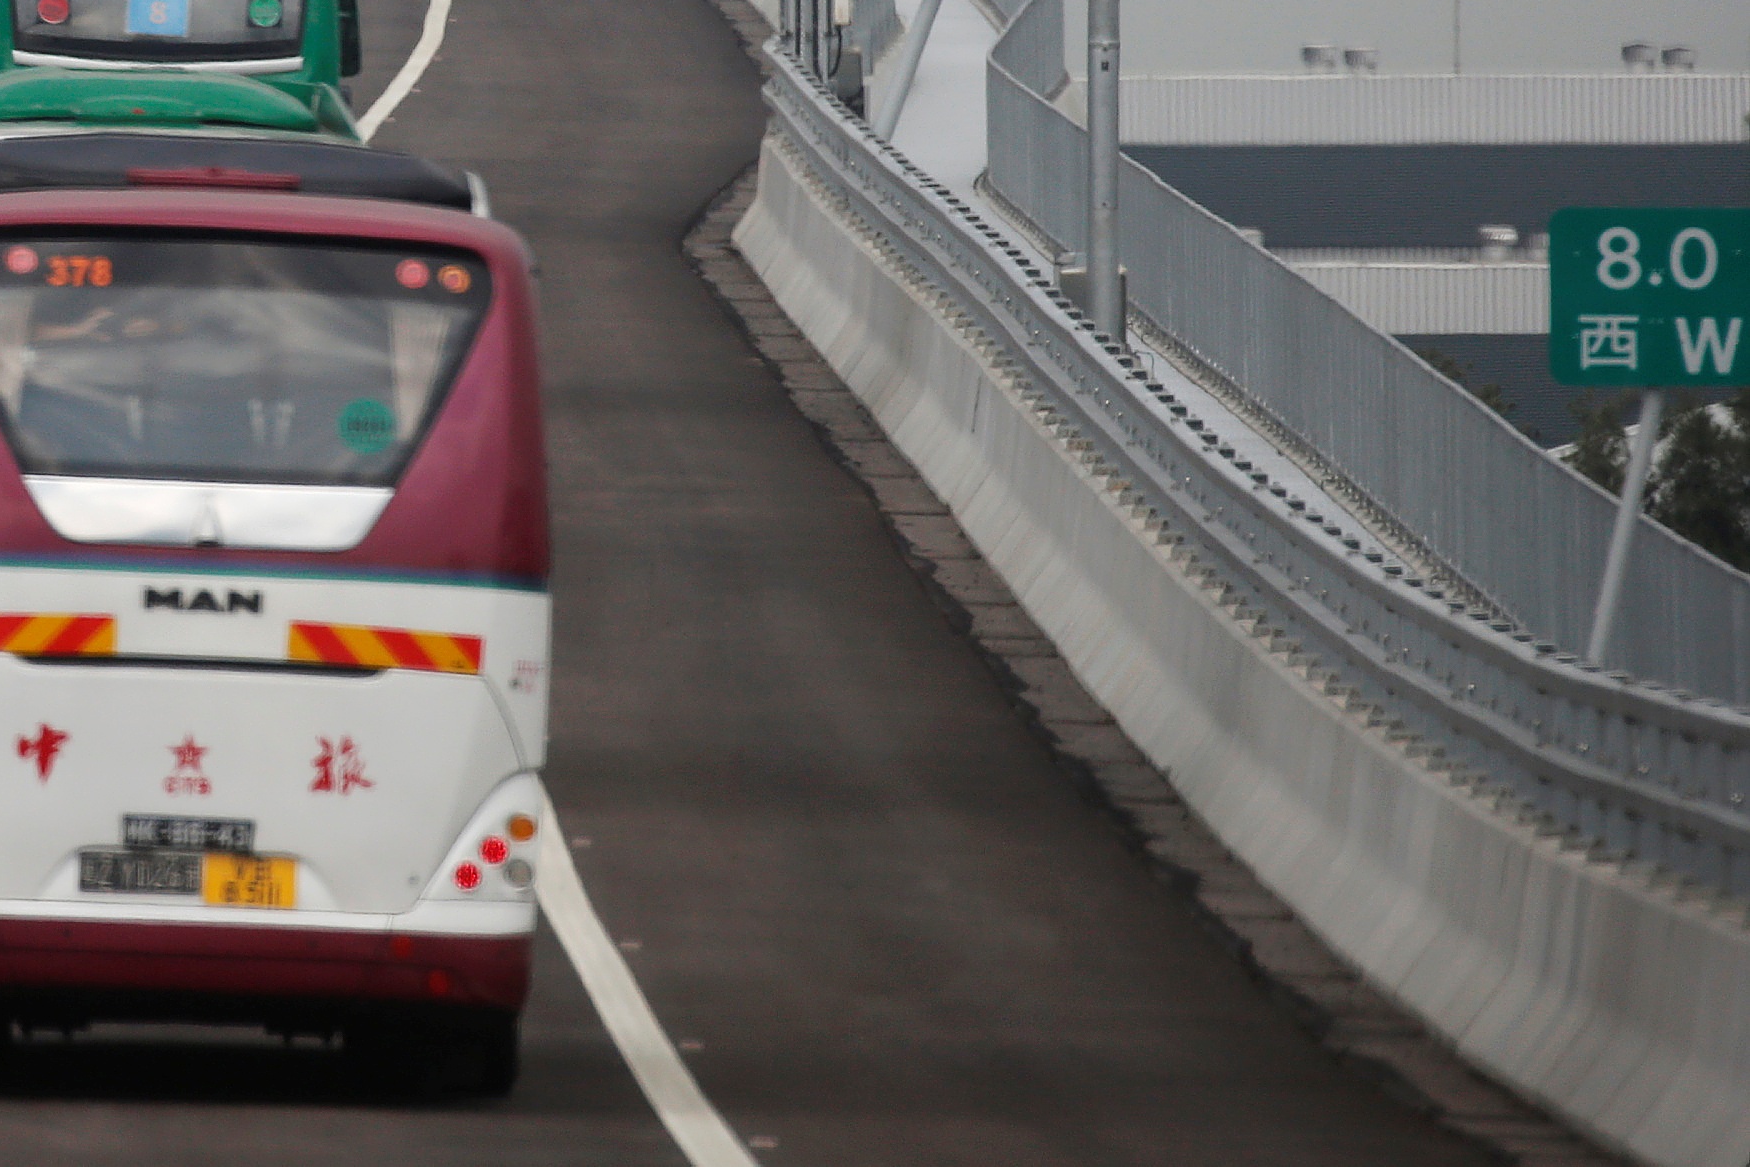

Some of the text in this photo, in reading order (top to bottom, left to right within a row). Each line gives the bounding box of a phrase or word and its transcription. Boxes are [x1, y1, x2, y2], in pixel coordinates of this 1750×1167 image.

[149, 0, 168, 25] 8
[46, 254, 113, 287] 378
[1596, 226, 1719, 291] 8.0
[1577, 314, 1743, 376] 西 W
[143, 585, 263, 615] MAN
[14, 721, 72, 783] 中
